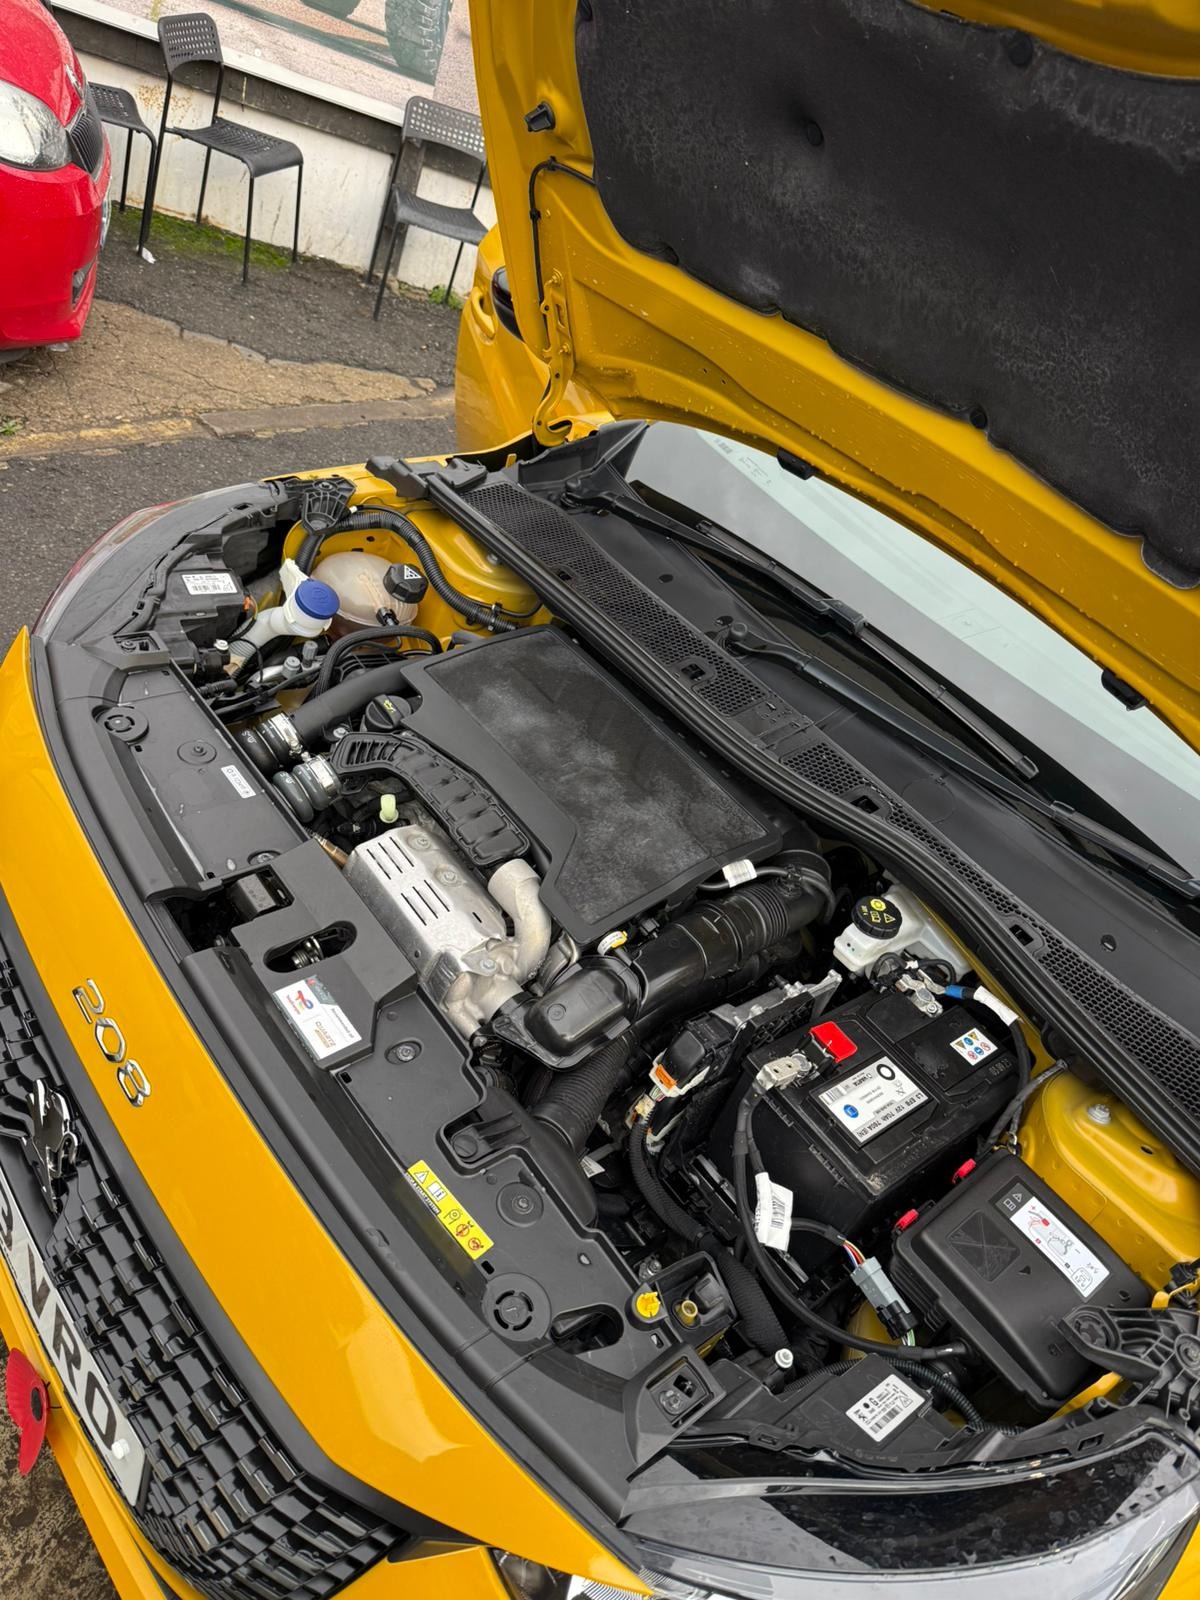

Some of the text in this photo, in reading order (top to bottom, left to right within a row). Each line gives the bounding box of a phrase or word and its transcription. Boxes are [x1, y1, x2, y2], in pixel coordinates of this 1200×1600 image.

[72, 978, 151, 1107] 208
[904, 1097, 916, 1106] EFB
[893, 1104, 905, 1113] 12V
[880, 1110, 894, 1122] 70Ah
[28, 1243, 117, 1451] VRO
